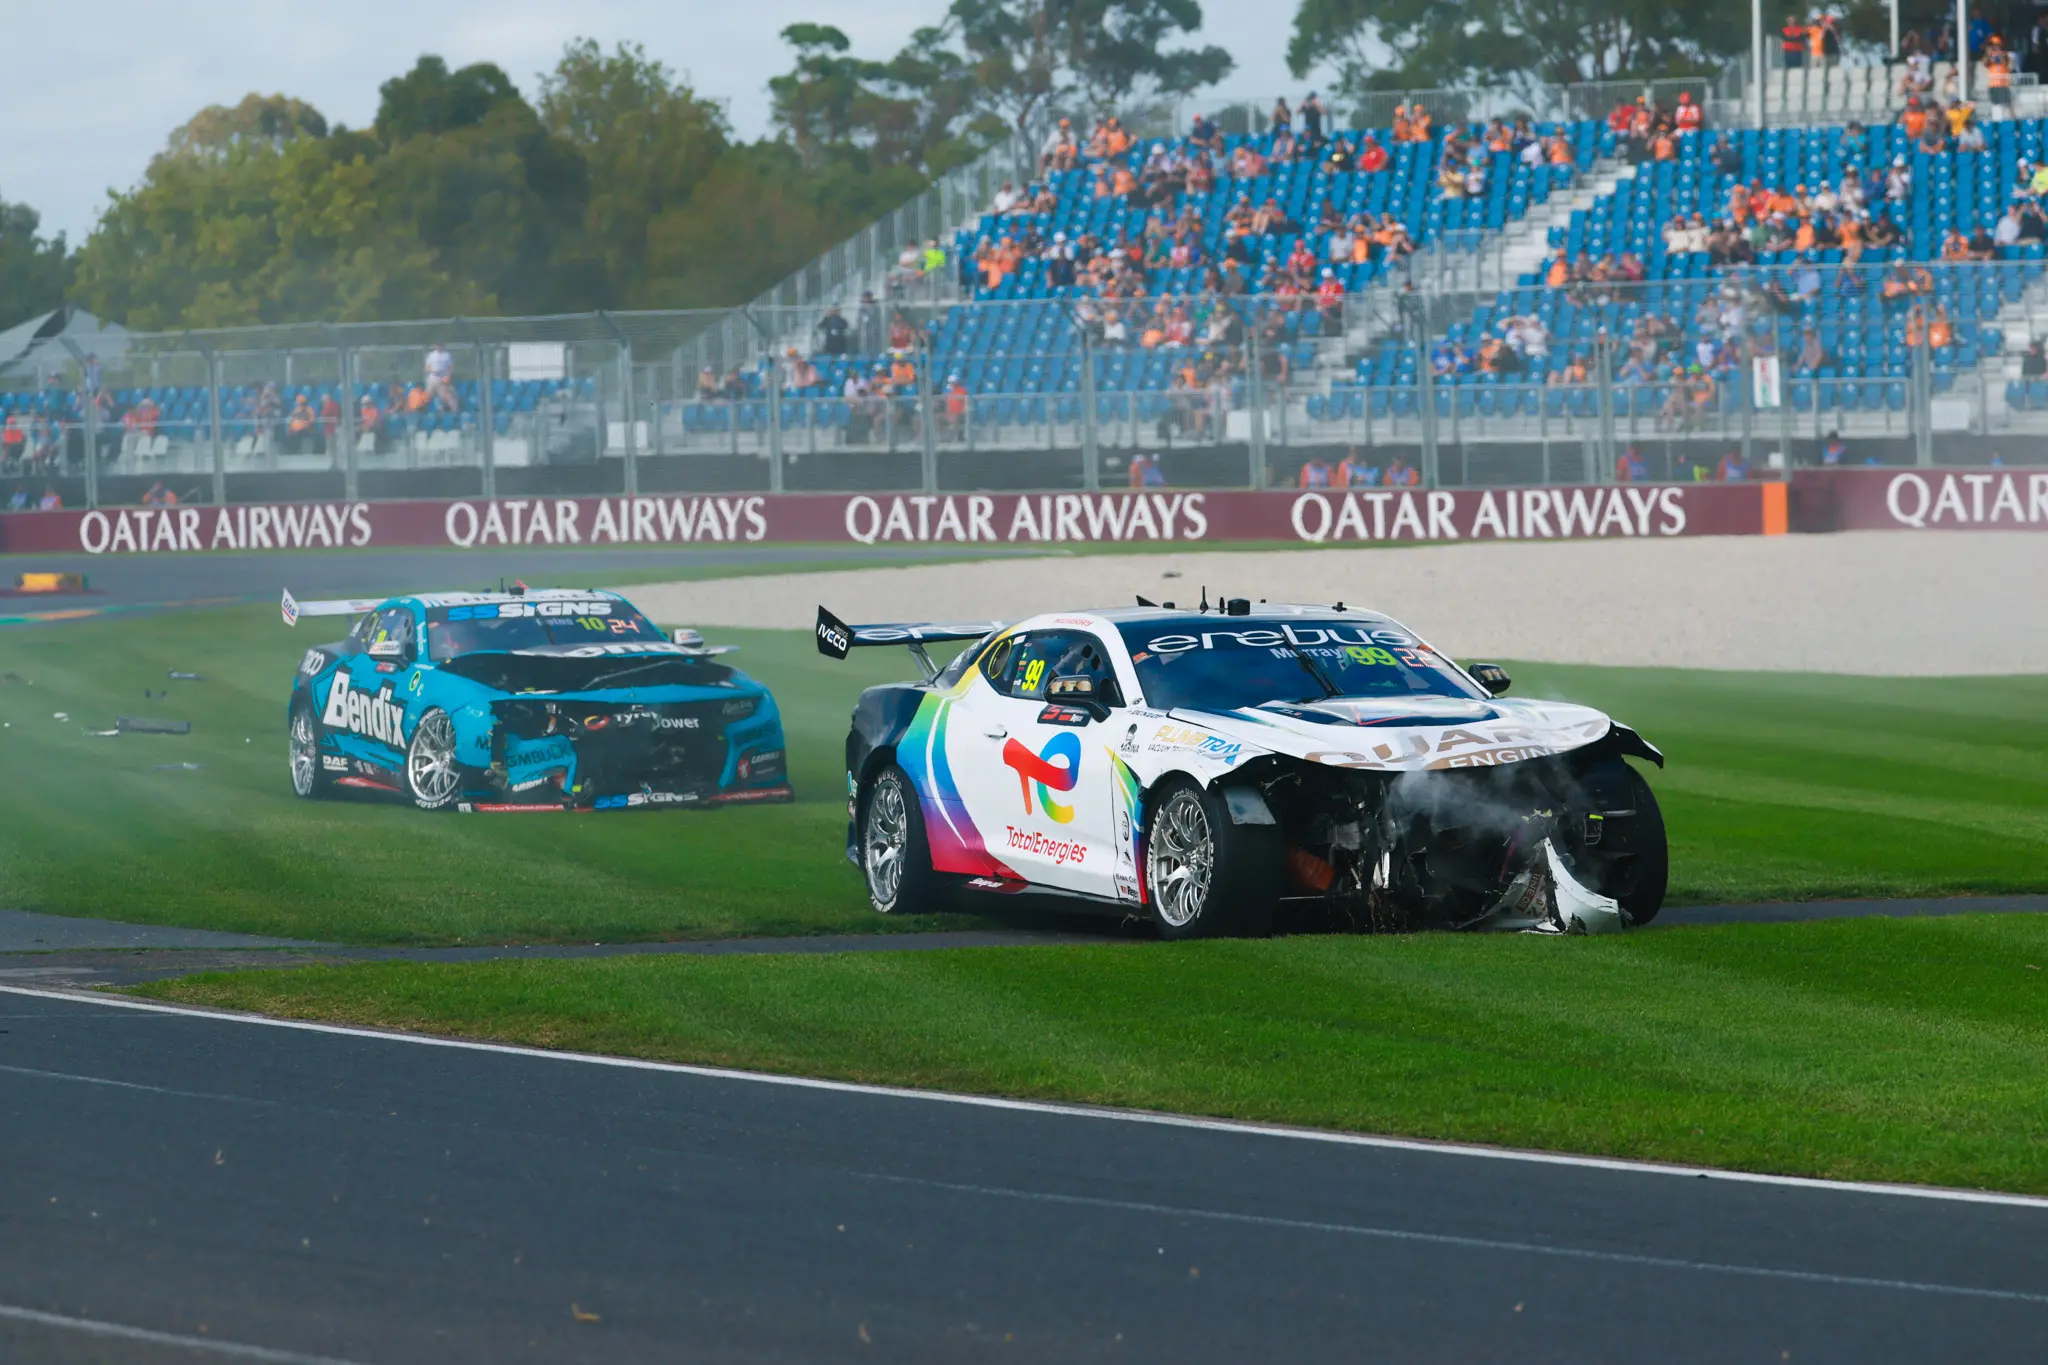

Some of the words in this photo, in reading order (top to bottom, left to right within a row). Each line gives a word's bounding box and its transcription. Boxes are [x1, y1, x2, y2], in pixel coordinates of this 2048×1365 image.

[79, 507, 202, 553] QATAR
[211, 505, 372, 549] AIRWAYS
[445, 500, 581, 547] QATAR
[590, 497, 767, 542] AIRWAYS
[845, 495, 997, 544] QATAR
[1007, 493, 1208, 541] AIRWAYS
[1291, 491, 1459, 542] QATAR
[1471, 487, 1686, 538] AIRWAYS
[576, 616, 606, 632] 10
[608, 618, 640, 634] 24
[818, 624, 848, 651] IVECO
[1148, 624, 1413, 653] erebus
[1346, 646, 1397, 666] 99
[1021, 659, 1045, 692] 99
[323, 671, 406, 749] Bendix
[323, 755, 349, 767] DAF
[1006, 825, 1087, 864] TotalEnergies
